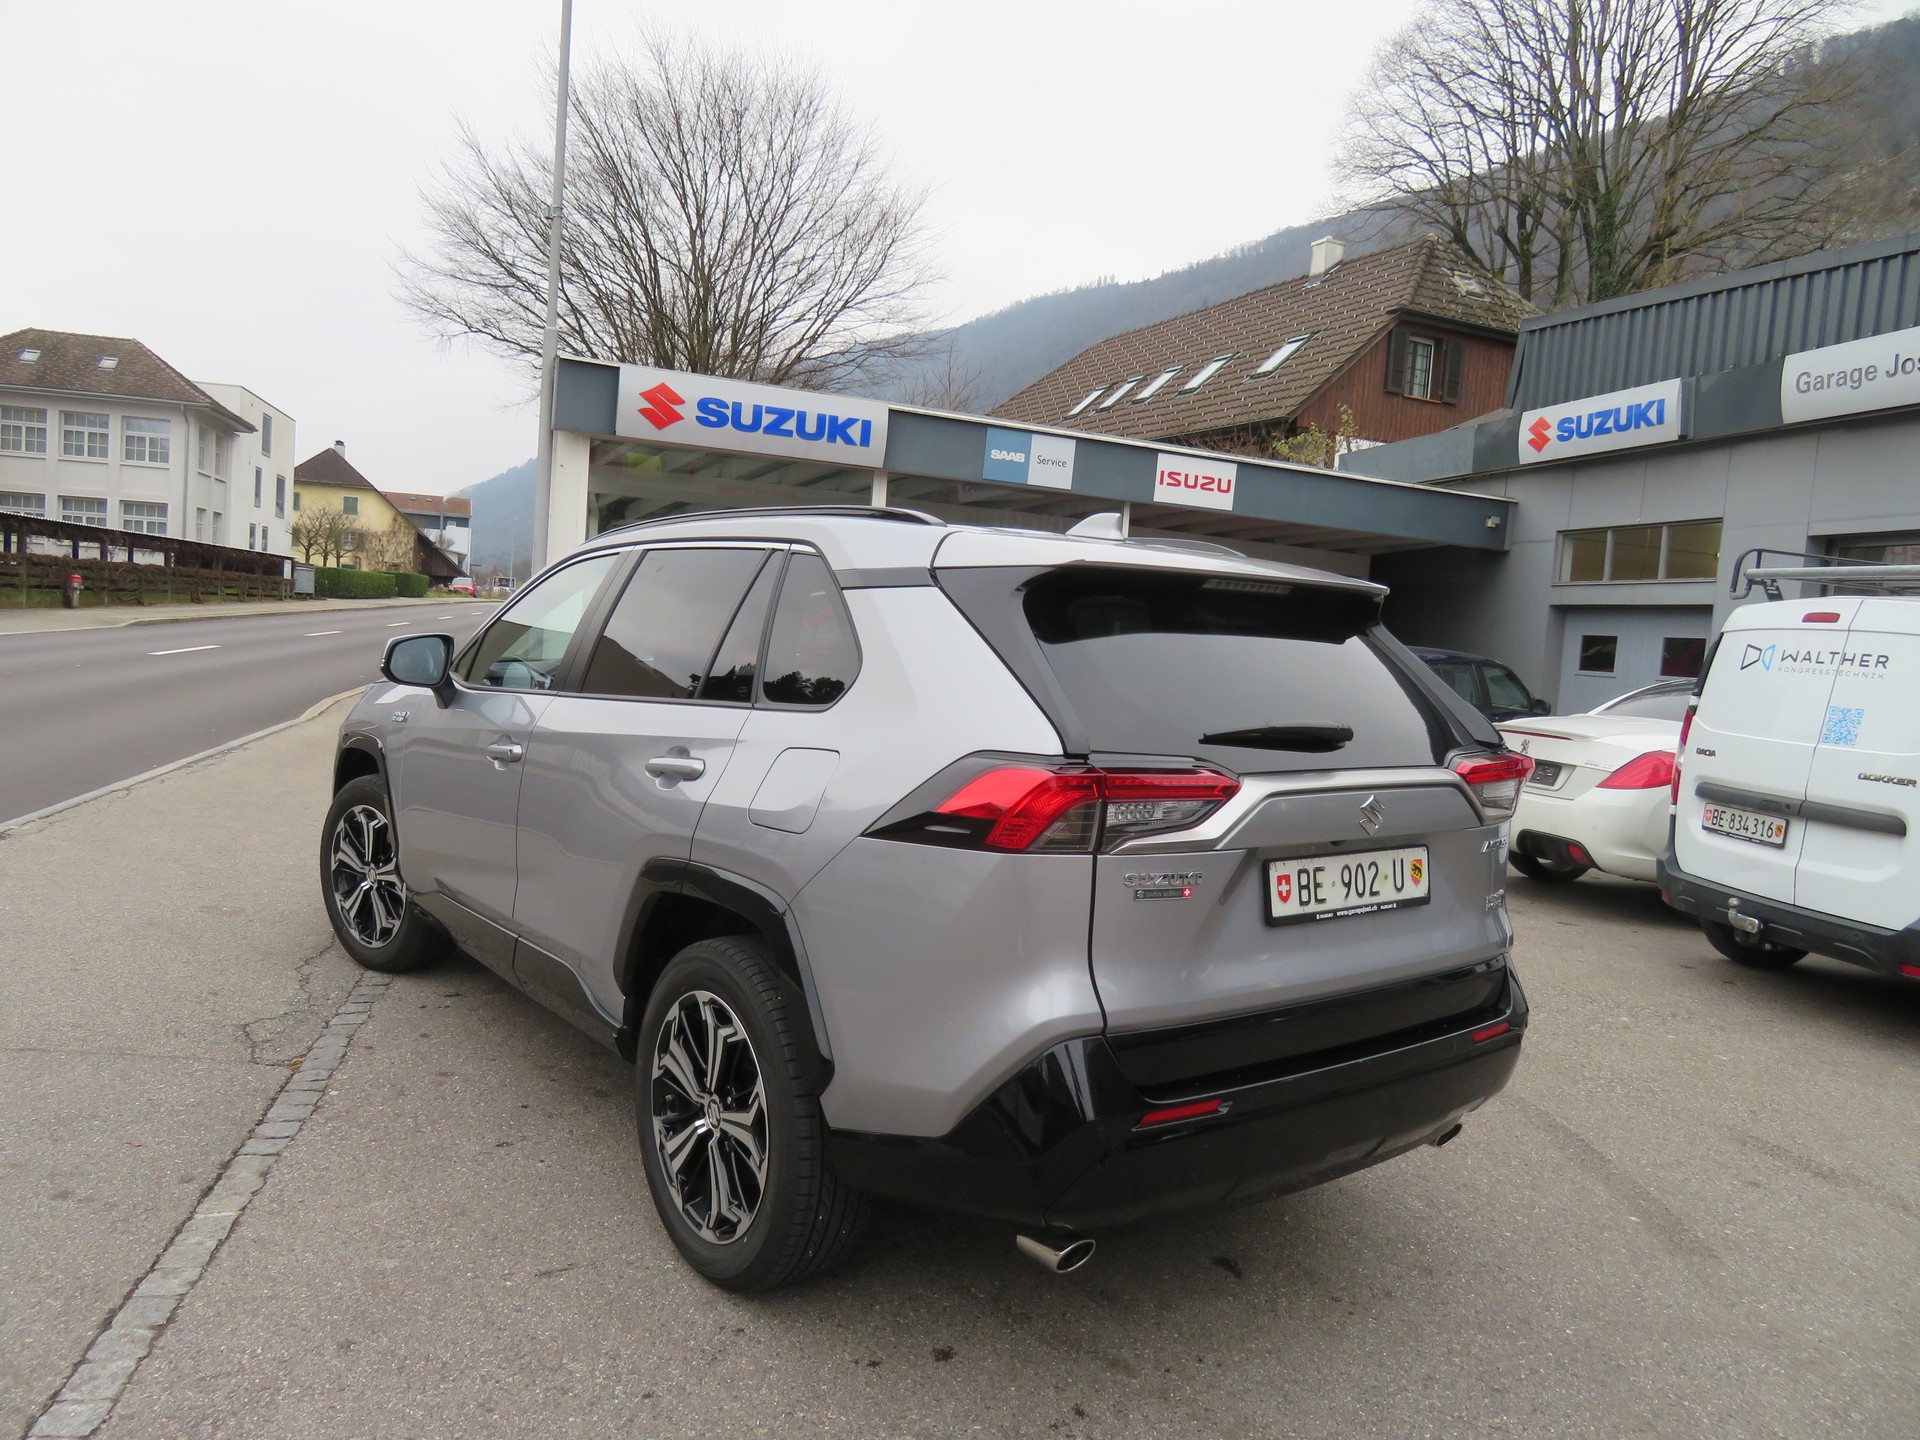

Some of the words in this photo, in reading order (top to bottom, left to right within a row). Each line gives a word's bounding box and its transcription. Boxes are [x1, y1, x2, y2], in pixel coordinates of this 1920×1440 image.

[1795, 364, 1878, 394] Garage
[695, 397, 872, 447] SUZUKI
[1556, 398, 1666, 442] SUZUKI
[990, 449, 1025, 463] SAAB
[1036, 454, 1067, 468] Service
[1159, 470, 1232, 494] ISUZU
[1780, 649, 1889, 669] WALTHER
[1777, 666, 1885, 680] KONGRESSTECHNIK
[1858, 772, 1917, 788] DOKKER
[1711, 808, 1727, 828] BE
[1124, 871, 1203, 888] SUZUKI
[1297, 866, 1327, 906] BE
[1340, 861, 1381, 900] 902
[1392, 857, 1405, 893] U
